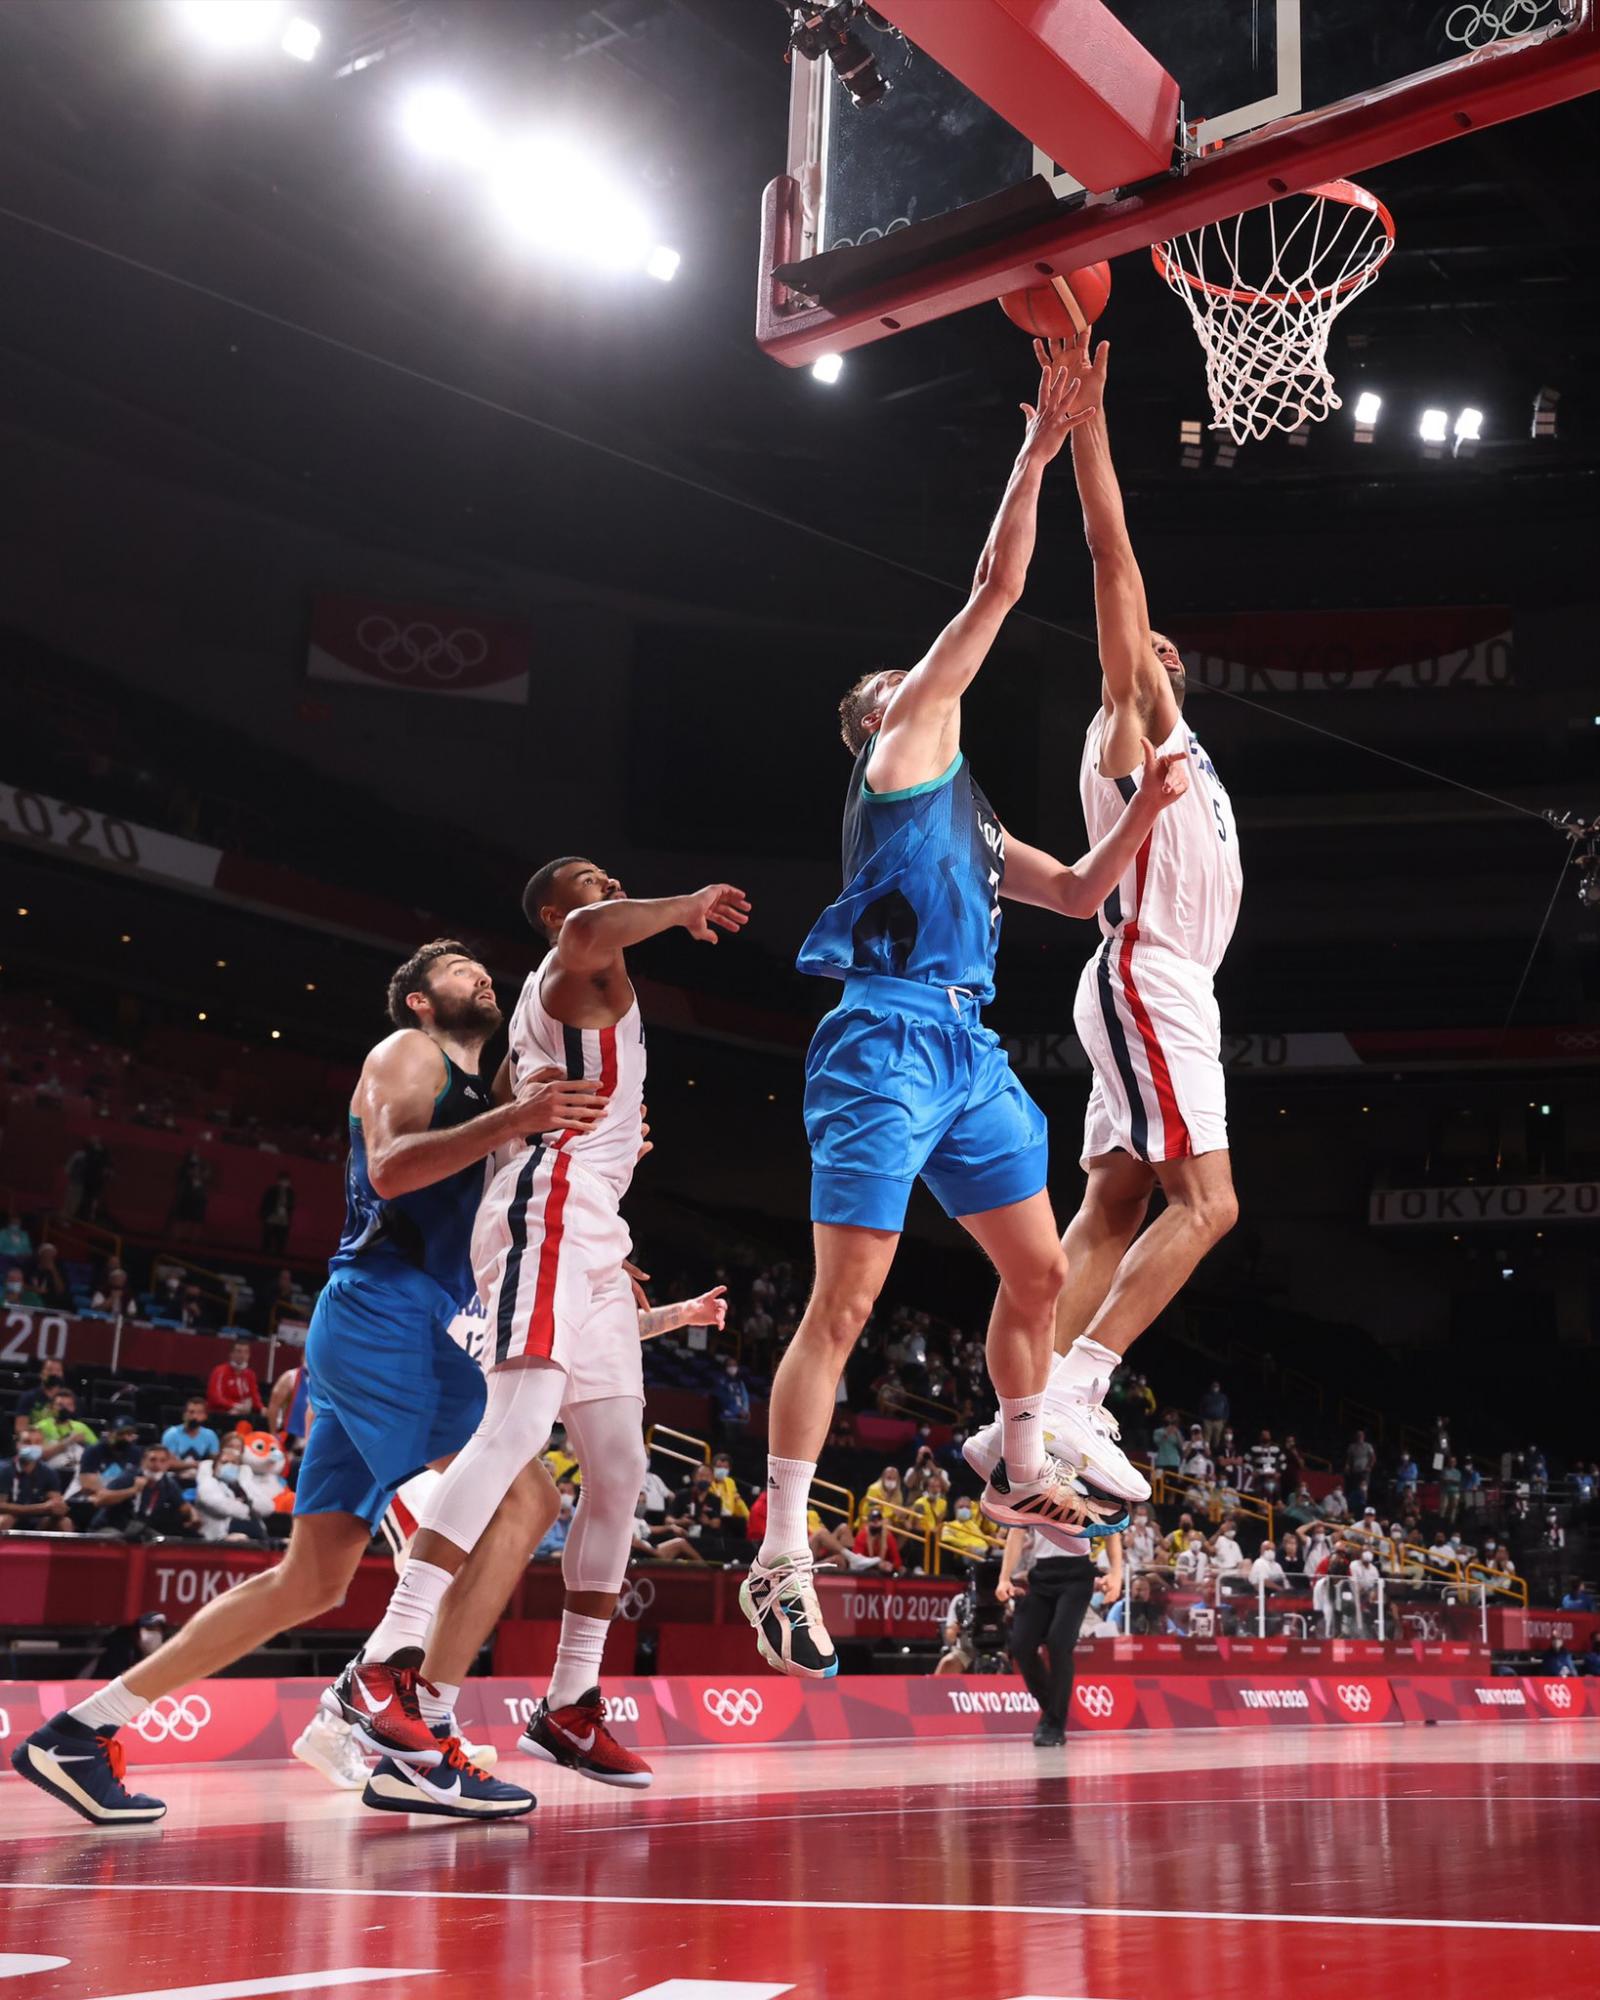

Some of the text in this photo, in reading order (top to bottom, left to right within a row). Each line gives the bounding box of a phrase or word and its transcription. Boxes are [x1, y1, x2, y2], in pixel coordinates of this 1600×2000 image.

[1196, 641, 1354, 692] OKYO
[0, 788, 139, 863] 020
[1213, 798, 1227, 842] 5
[1375, 1184, 1599, 1221] TOKYO 20
[0, 1311, 68, 1363] 20
[156, 1568, 257, 1604] TOKY
[842, 1594, 950, 1621] TOKYO 2020
[948, 1691, 1040, 1713] TOKYO 2020
[1239, 1690, 1309, 1708] TOKYO 2020
